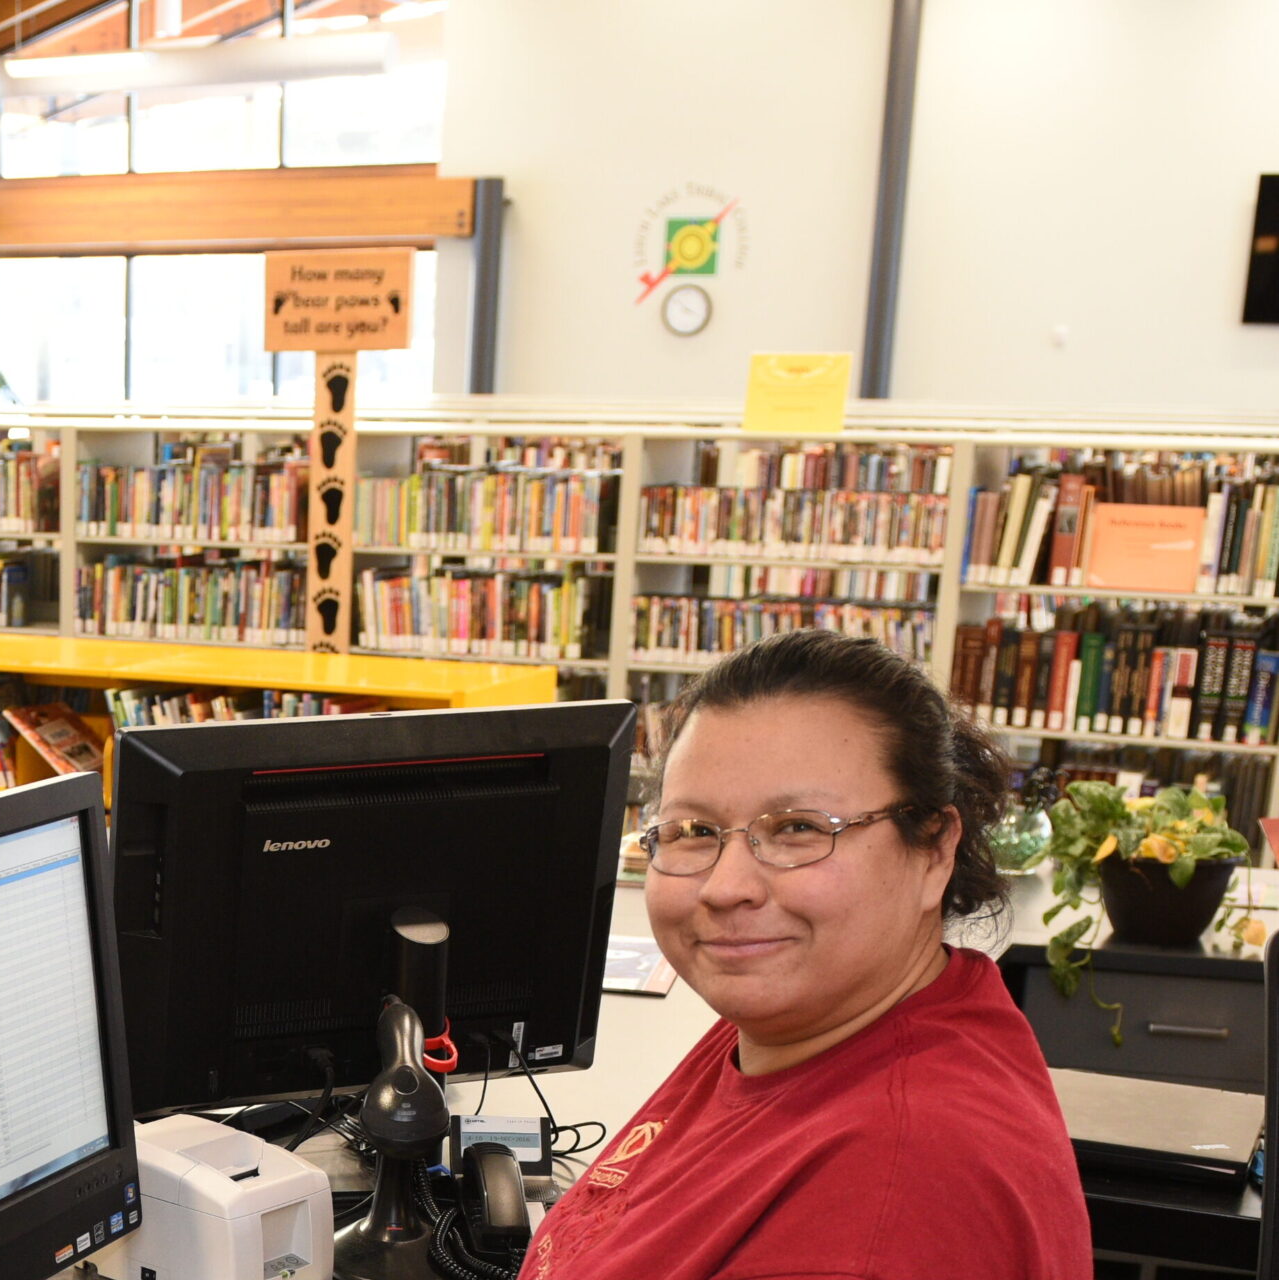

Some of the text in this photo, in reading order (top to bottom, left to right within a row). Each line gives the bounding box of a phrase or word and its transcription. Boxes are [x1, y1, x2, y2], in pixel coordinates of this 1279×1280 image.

[290, 264, 385, 285] How many
[292, 292, 380, 312] bear paws
[283, 316, 389, 338] tall are you?
[263, 838, 331, 852] lenovo
